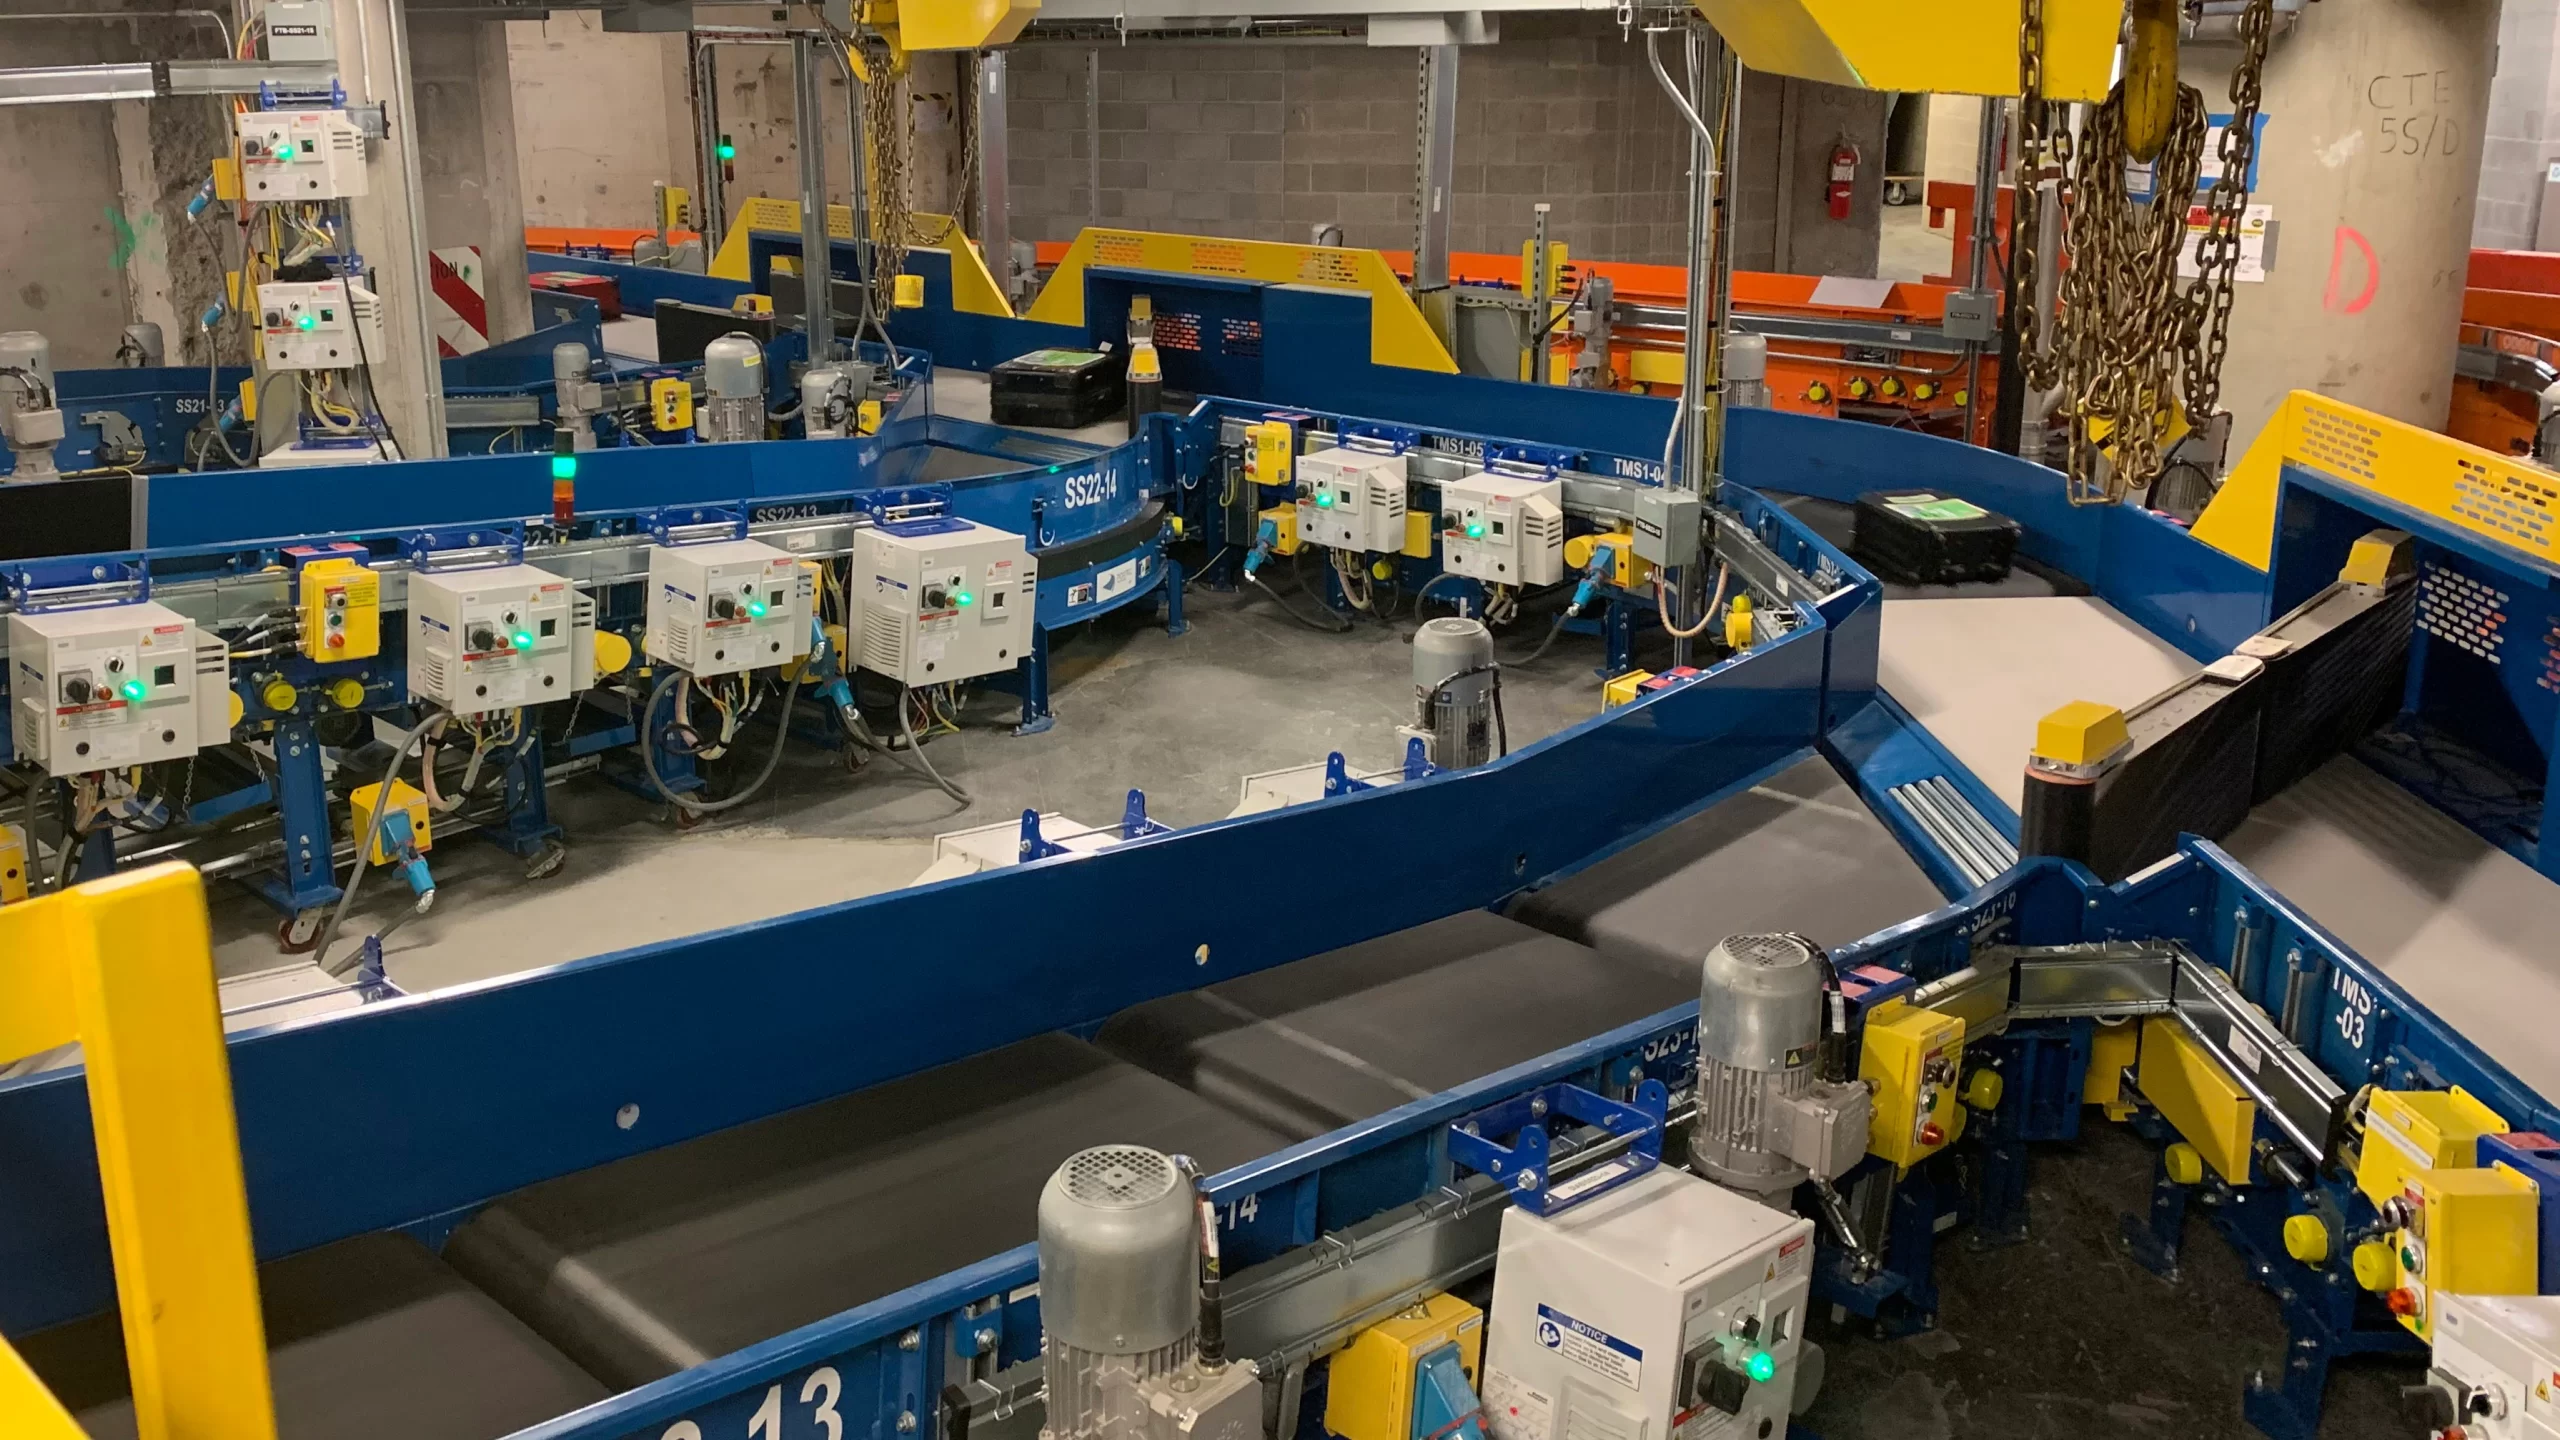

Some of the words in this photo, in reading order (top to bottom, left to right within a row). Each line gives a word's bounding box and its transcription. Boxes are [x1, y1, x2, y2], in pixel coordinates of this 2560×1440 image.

[2368, 70, 2450, 109] CTE
[2322, 225, 2380, 315] D
[176, 399, 225, 414] SS21-3
[1431, 435, 1484, 457] TMS1-05
[1064, 468, 1117, 509] SS22-14
[756, 505, 818, 524] SS22-13
[2333, 967, 2377, 1015] TMS
[1571, 1320, 1608, 1344] NOTICE
